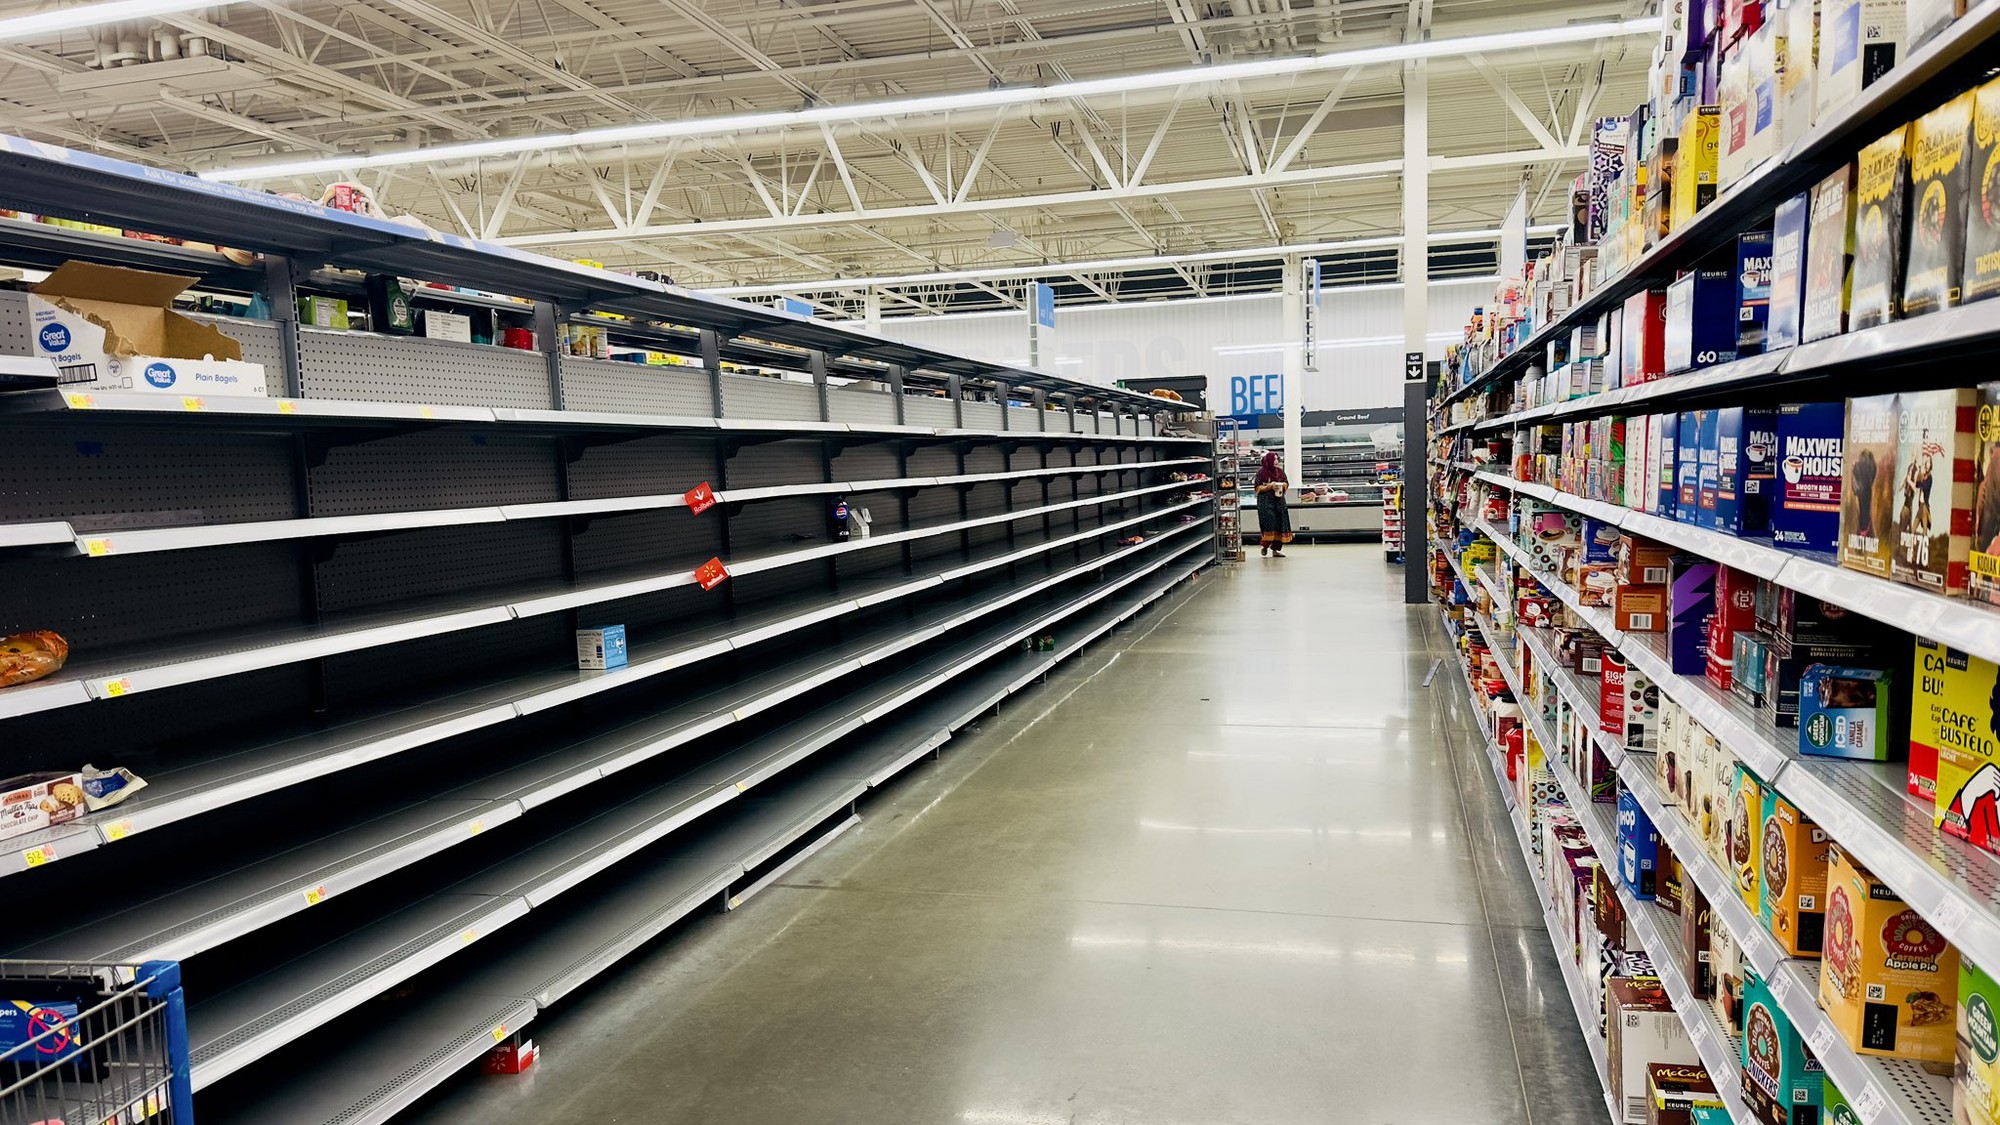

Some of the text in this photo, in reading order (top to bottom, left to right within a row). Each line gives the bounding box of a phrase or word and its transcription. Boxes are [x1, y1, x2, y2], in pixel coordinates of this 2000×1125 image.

[1744, 257, 1772, 270] MAX
[42, 330, 65, 341] Great
[58, 353, 82, 363] Bagels
[1696, 350, 1717, 363] 60
[148, 367, 172, 377] Great
[195, 373, 238, 384] Plain Bagels
[1231, 374, 1284, 415] BEE
[1802, 457, 1844, 476] HOUS
[694, 498, 716, 514] Rollback
[1774, 530, 1784, 541] 24
[1977, 552, 1998, 574] KODIAK
[1740, 590, 1750, 608] FDC
[1948, 658, 1966, 668] KEURIG
[1834, 716, 1846, 748] ICED
[1940, 725, 1993, 756] BUSTELO
[1910, 772, 1919, 786] 24
[0, 814, 38, 830] CHOCOLATE CHIP
[1778, 806, 1794, 825] Duos
[1894, 920, 1916, 942] DONUT
[1899, 943, 1929, 952] COFFEE
[1886, 958, 1938, 972] Apple Pie
[1890, 952, 1934, 964] Caramel
[1972, 1005, 1992, 1034] GREEN
[1968, 1016, 1997, 1052] MOUNTAIN
[1748, 1060, 1780, 1099] SNICKERS
